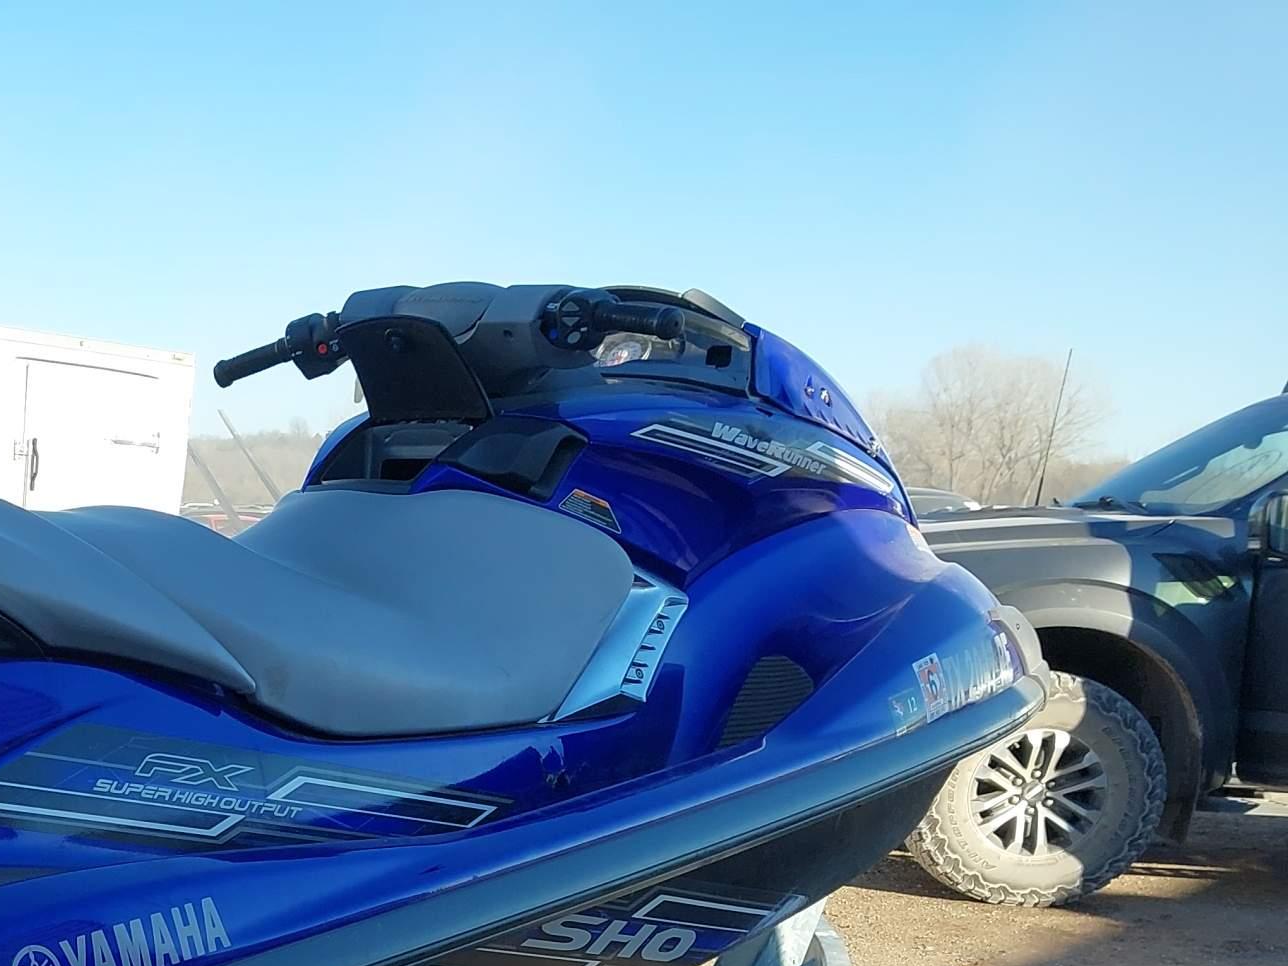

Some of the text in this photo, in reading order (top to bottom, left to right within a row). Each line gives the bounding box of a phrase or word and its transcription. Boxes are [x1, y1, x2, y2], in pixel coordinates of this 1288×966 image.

[711, 421, 827, 475] WaveRunner
[135, 752, 256, 792] FX
[93, 778, 303, 818] SUPER HIGH OUTPUT
[520, 914, 697, 962] SHO
